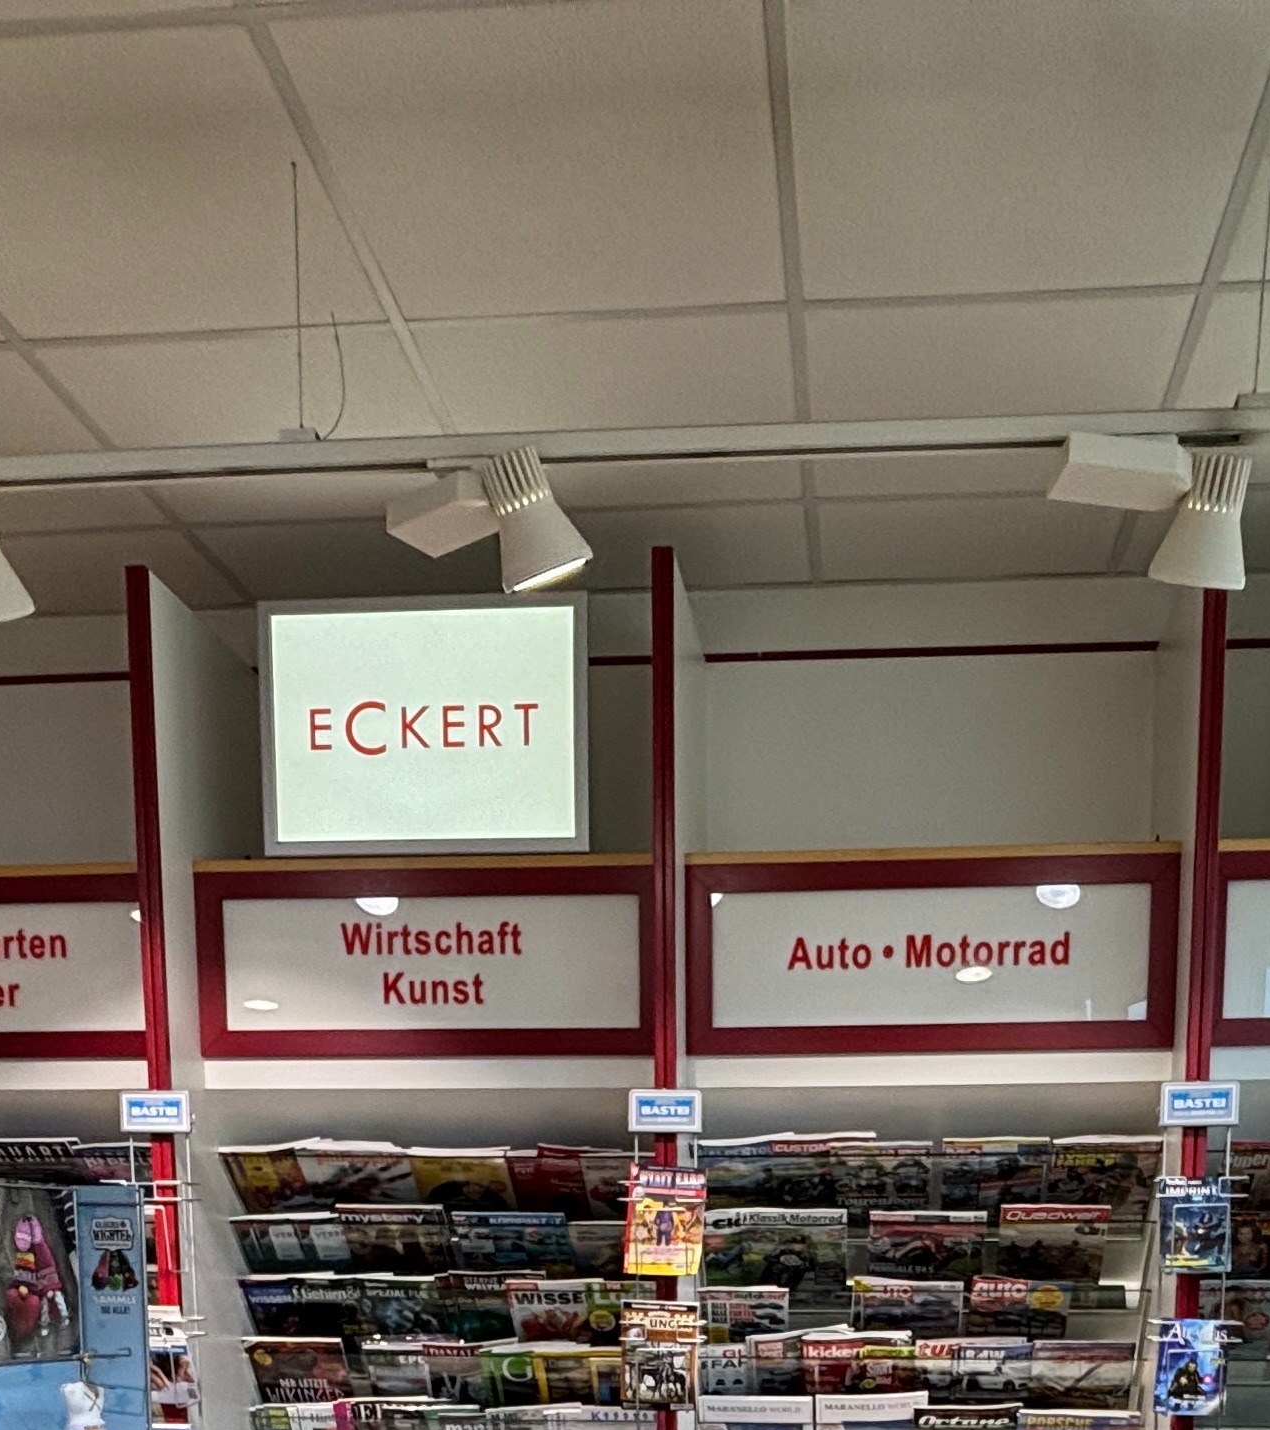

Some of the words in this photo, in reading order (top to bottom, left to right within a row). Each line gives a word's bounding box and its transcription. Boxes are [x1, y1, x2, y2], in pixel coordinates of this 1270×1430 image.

[310, 701, 538, 756] ECKERT
[342, 921, 522, 956] Wirtschaft
[788, 936, 873, 970] Auto
[905, 932, 1071, 968] Motorrad
[384, 972, 485, 1005] Kunst
[341, 1213, 425, 1225] mystery
